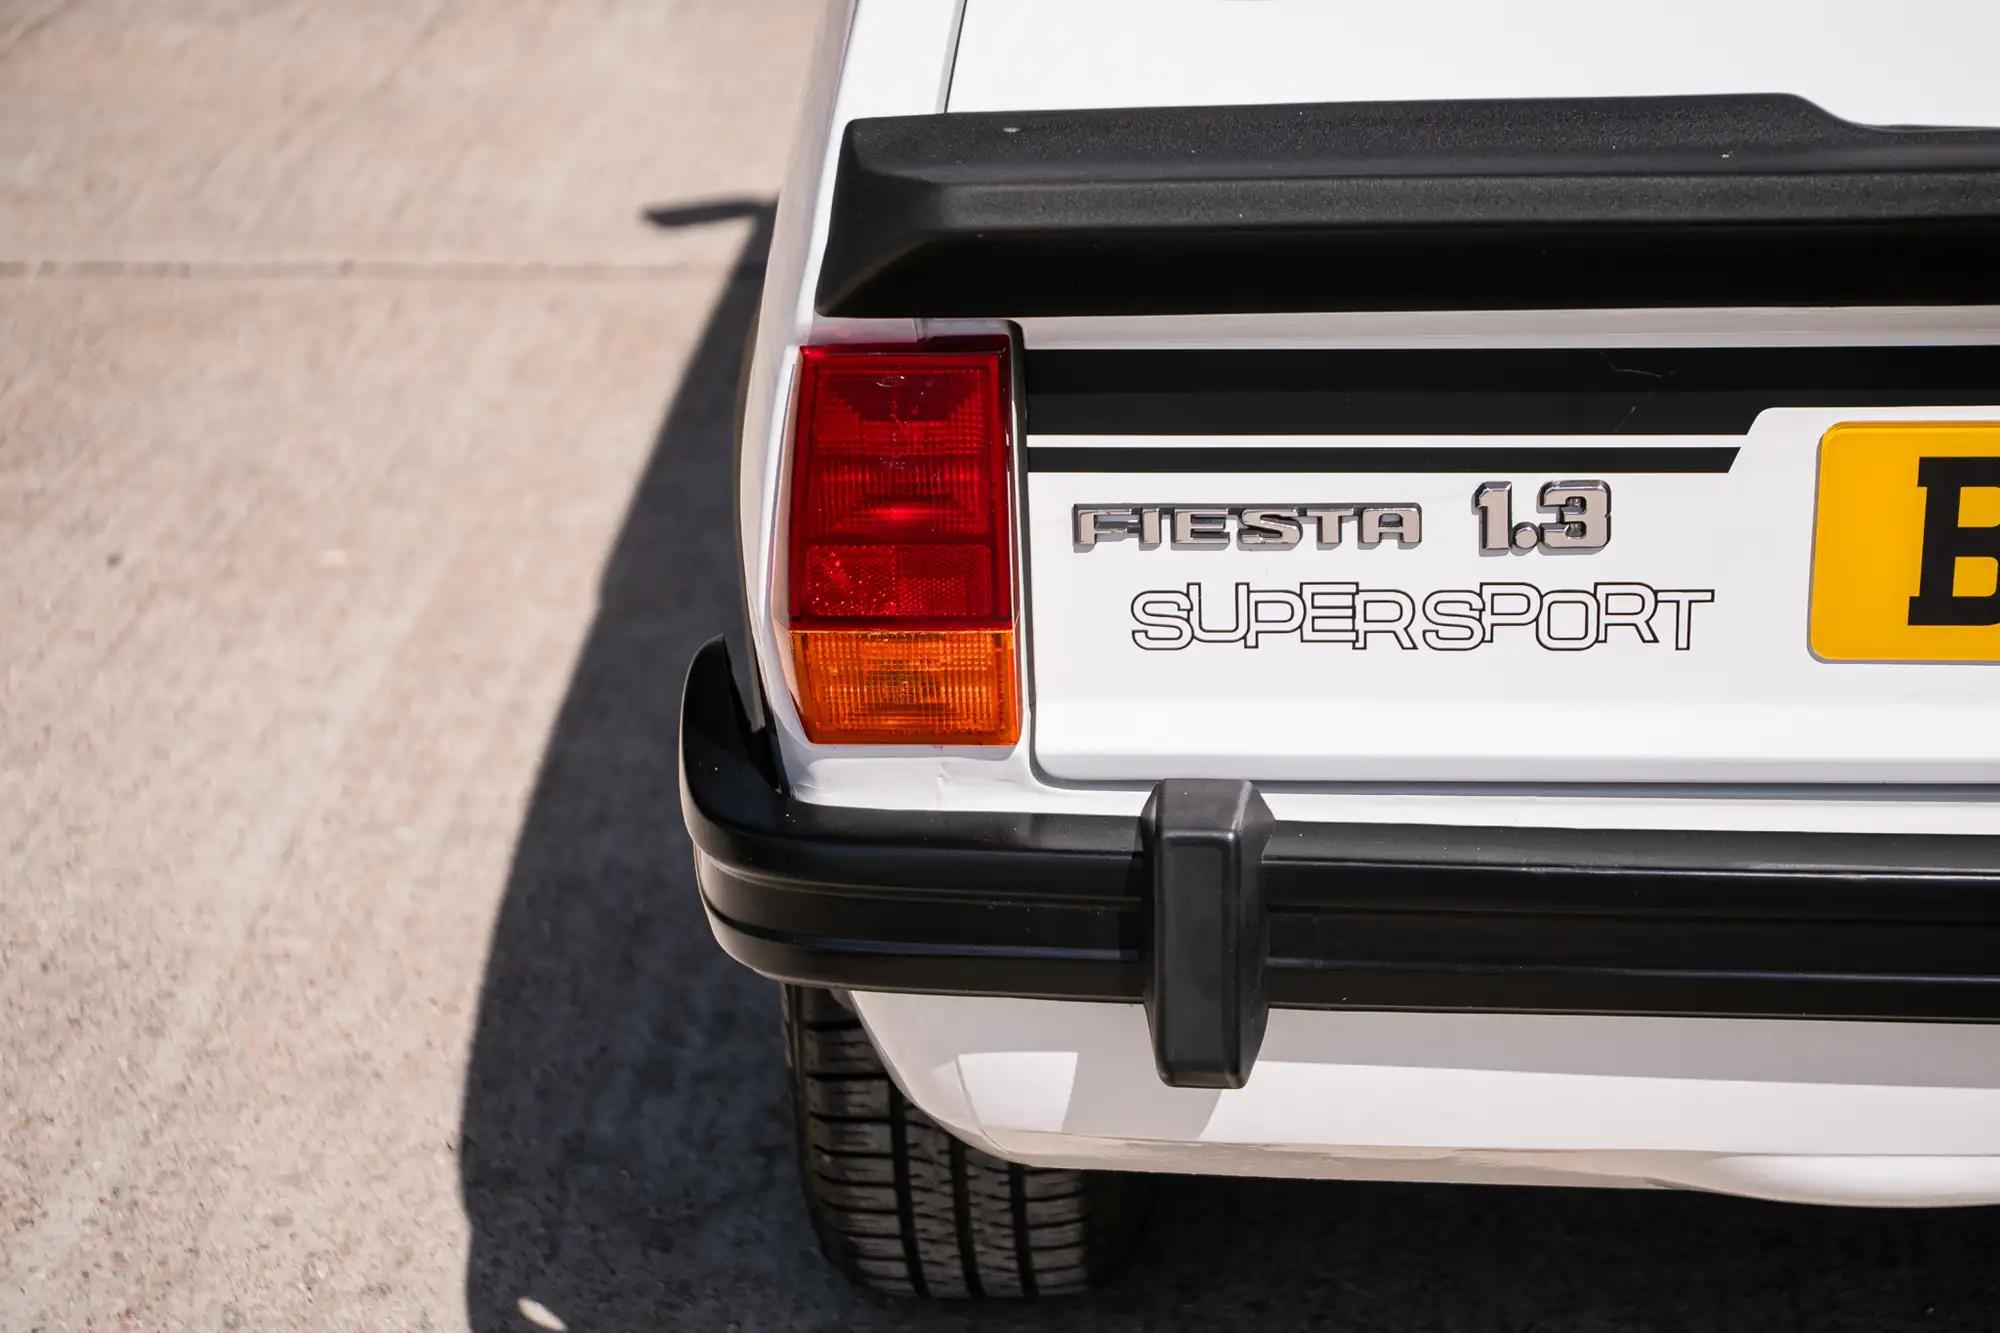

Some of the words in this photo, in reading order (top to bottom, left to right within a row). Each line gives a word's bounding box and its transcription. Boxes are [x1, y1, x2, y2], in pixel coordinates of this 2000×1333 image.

[1073, 503, 1422, 548] FIESTA
[1472, 480, 1612, 552] 1.3
[1131, 582, 1715, 651] SUPERSPORT
